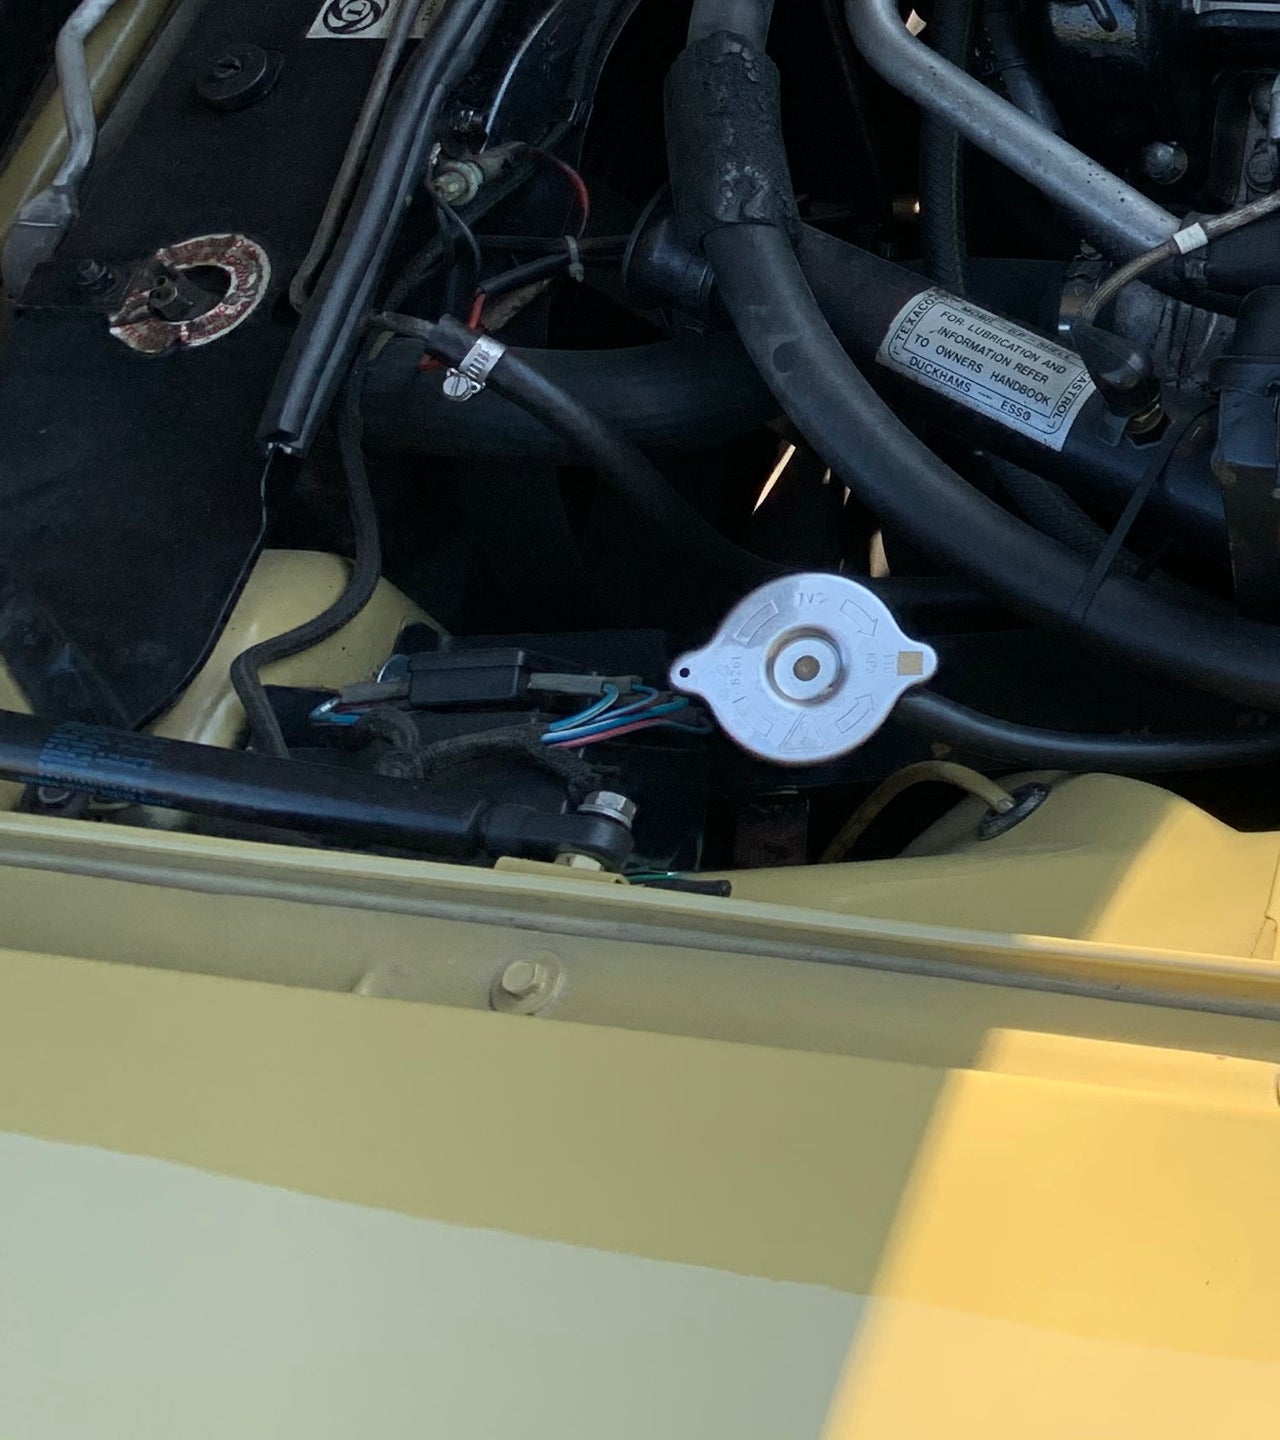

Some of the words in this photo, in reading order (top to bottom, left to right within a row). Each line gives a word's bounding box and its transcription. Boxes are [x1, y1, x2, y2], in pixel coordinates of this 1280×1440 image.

[895, 297, 936, 342] TEXACO
[940, 310, 964, 326] FOR
[967, 323, 1042, 362] LUBRICATION
[1041, 359, 1067, 375] AND
[913, 333, 930, 348] TO
[935, 344, 984, 374] OWNERS
[989, 370, 1052, 407] HANDBOOK
[937, 326, 1012, 367] INFORMATION
[1013, 362, 1049, 385] REFER
[909, 356, 972, 393] DUCKHAMS
[1000, 400, 1032, 421] ESSO
